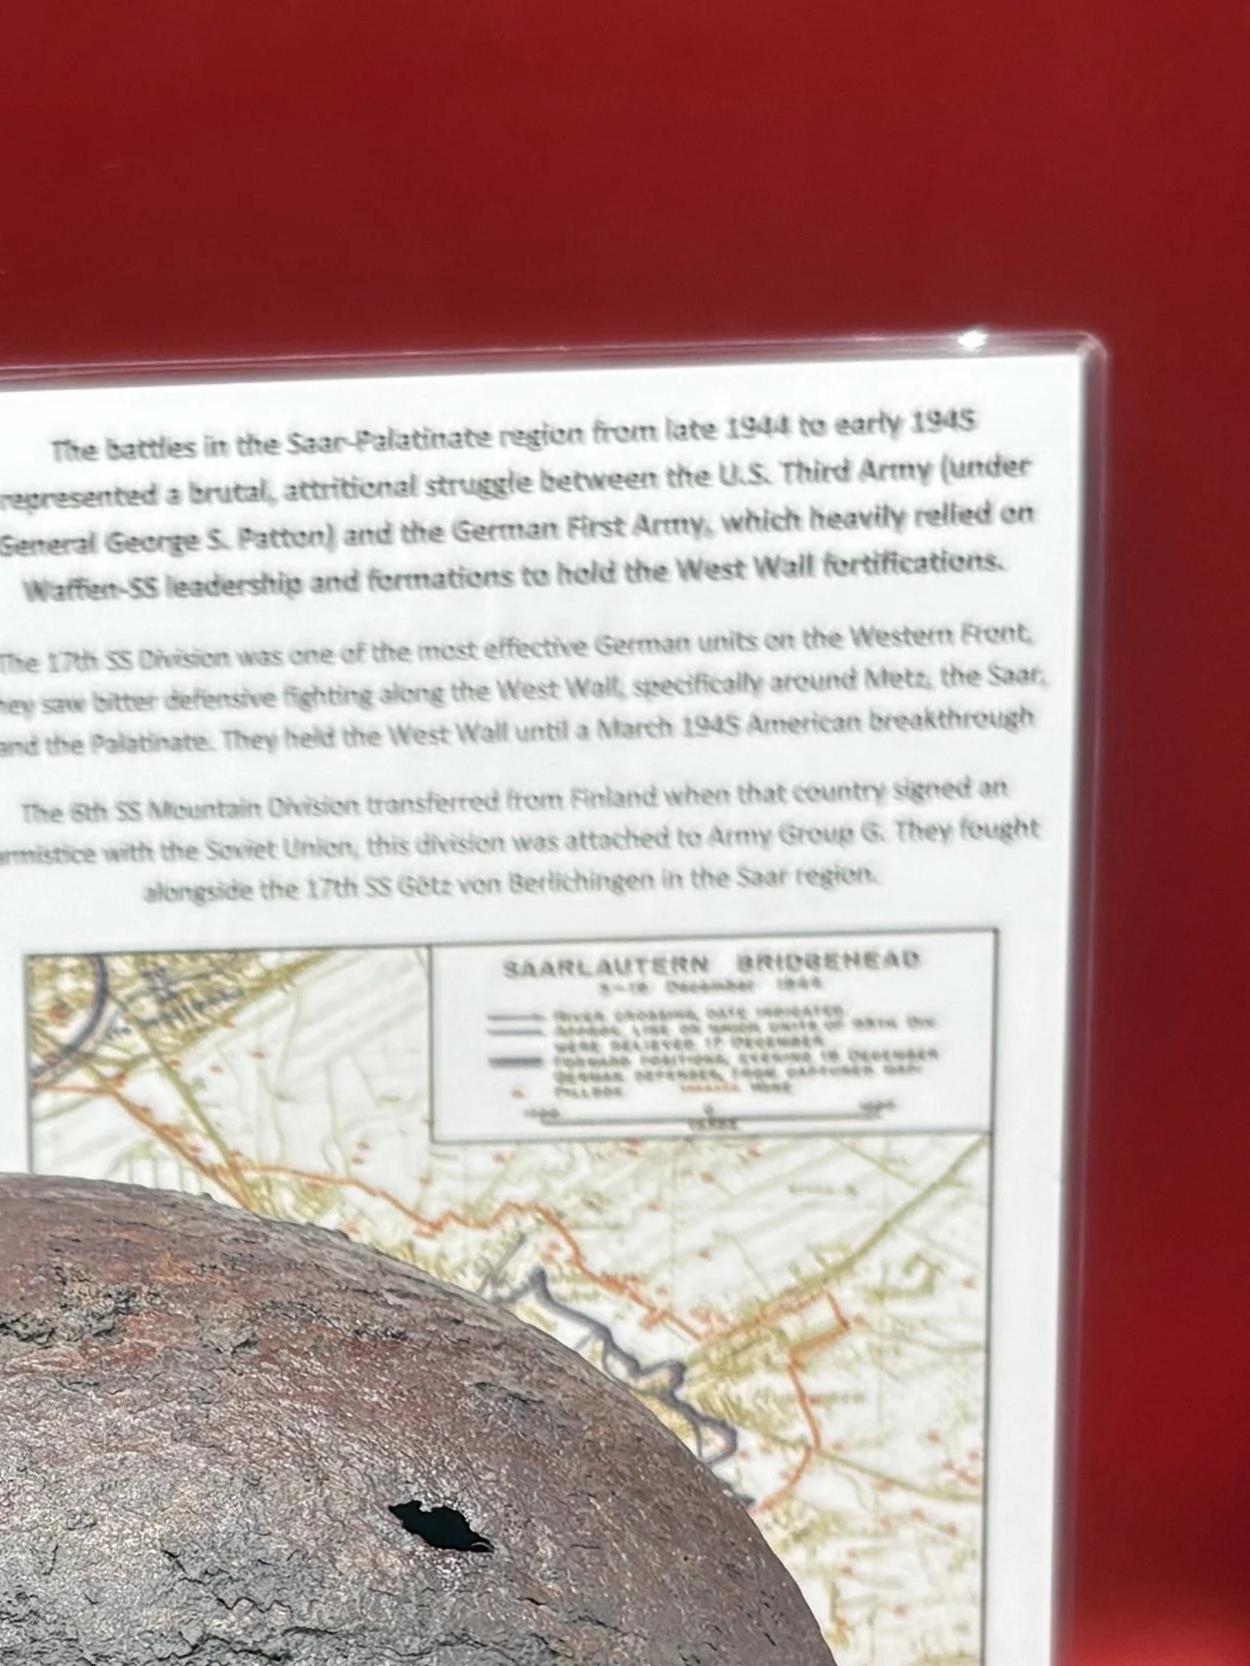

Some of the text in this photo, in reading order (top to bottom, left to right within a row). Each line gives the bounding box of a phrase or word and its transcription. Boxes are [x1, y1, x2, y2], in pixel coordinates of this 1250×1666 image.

[50, 407, 978, 463] The battles in the Saar-Palatinate region from late 1944 to early 1945
[165, 486, 183, 506] a
[187, 476, 278, 507] brutal,
[283, 472, 419, 502] attritional
[424, 468, 534, 503] struggle
[539, 464, 659, 493] between
[665, 461, 712, 488] the
[718, 460, 773, 487] U.S.
[779, 456, 853, 485] Third
[857, 455, 935, 488] Army
[939, 450, 1034, 485] (under
[103, 527, 202, 560] George
[206, 526, 231, 551] S.
[237, 521, 338, 555] Patton)
[342, 520, 395, 546] and
[399, 518, 446, 545] the
[451, 515, 560, 543] German
[566, 512, 628, 539] First
[631, 510, 715, 542] Army,
[720, 505, 803, 534] which
[808, 501, 909, 536] heavily
[913, 499, 995, 528] relied
[999, 504, 1036, 524] on
[21, 545, 1006, 604] Waffen-SS leadership and formations to hold the West Wall fortifications.
[43, 732, 86, 757] the
[220, 726, 280, 755] They
[283, 724, 337, 750] held
[340, 723, 383, 748] the
[386, 721, 452, 747] West
[454, 720, 510, 744] Wall
[514, 718, 570, 742] until
[574, 723, 591, 741] a
[596, 714, 675, 740] March
[682, 712, 742, 738] 1945
[745, 709, 863, 736] American
[868, 703, 1036, 737] breakthrough
[142, 877, 255, 909] alongside
[258, 876, 300, 901] the
[306, 875, 359, 900] 17th
[364, 874, 393, 898] SS
[456, 877, 502, 896] von
[508, 866, 656, 899] Berlichingen
[661, 867, 685, 889] in
[689, 864, 732, 889] the
[736, 864, 790, 888] Saar
[502, 947, 922, 979] SAARLAUTERN BRIDGEHEAD
